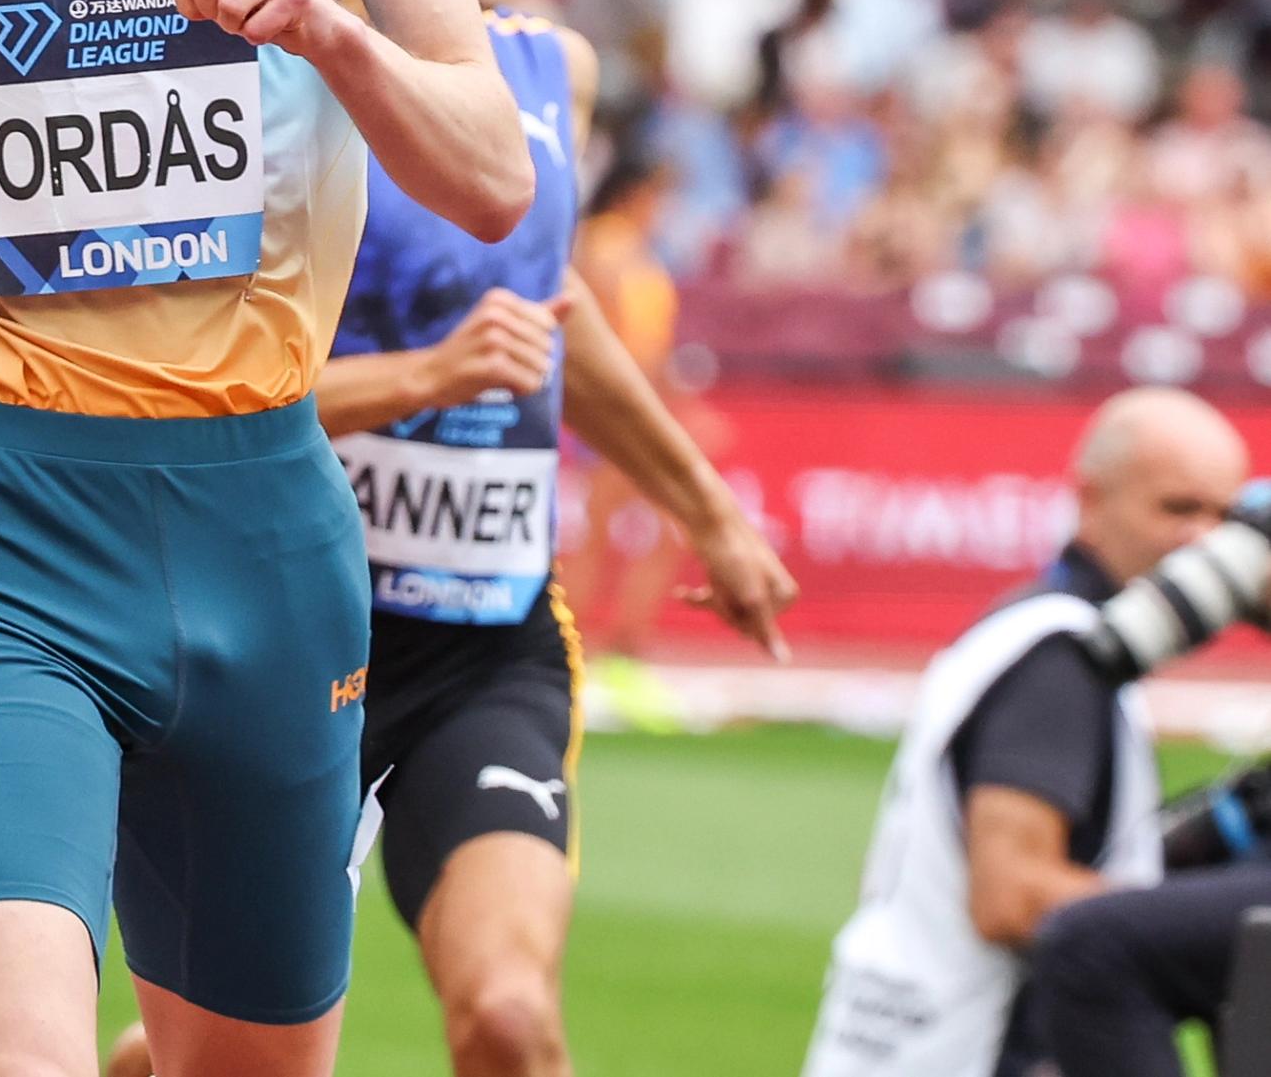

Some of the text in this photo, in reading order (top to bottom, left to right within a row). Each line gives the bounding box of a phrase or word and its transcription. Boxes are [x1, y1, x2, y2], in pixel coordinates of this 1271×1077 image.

[70, 14, 189, 44] DIAMOND
[66, 40, 165, 69] LEAGUE
[60, 230, 229, 278] LONDON
[341, 453, 535, 543] ANNER
